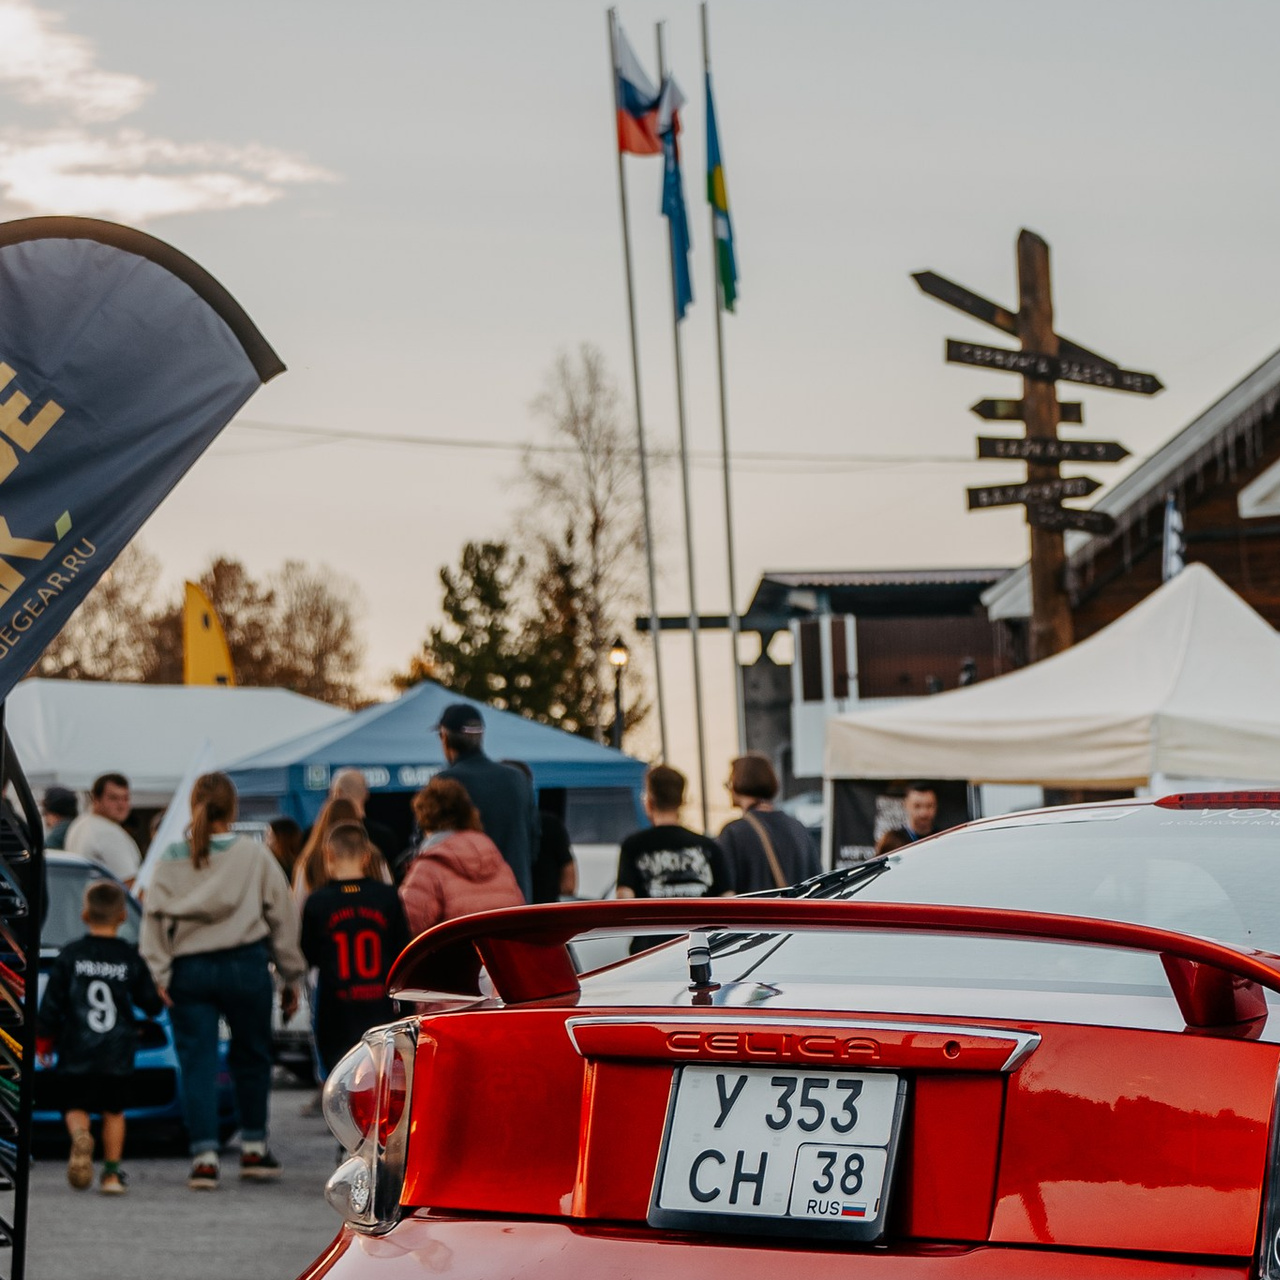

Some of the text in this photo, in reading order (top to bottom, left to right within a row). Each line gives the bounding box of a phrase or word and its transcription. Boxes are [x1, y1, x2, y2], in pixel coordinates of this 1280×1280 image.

[331, 929, 382, 980] 10
[87, 980, 117, 1033] 9
[666, 1031, 881, 1060] CELICA
[765, 1076, 864, 1133] 353
[812, 1151, 865, 1196] 38
[806, 1199, 840, 1216] RUS
